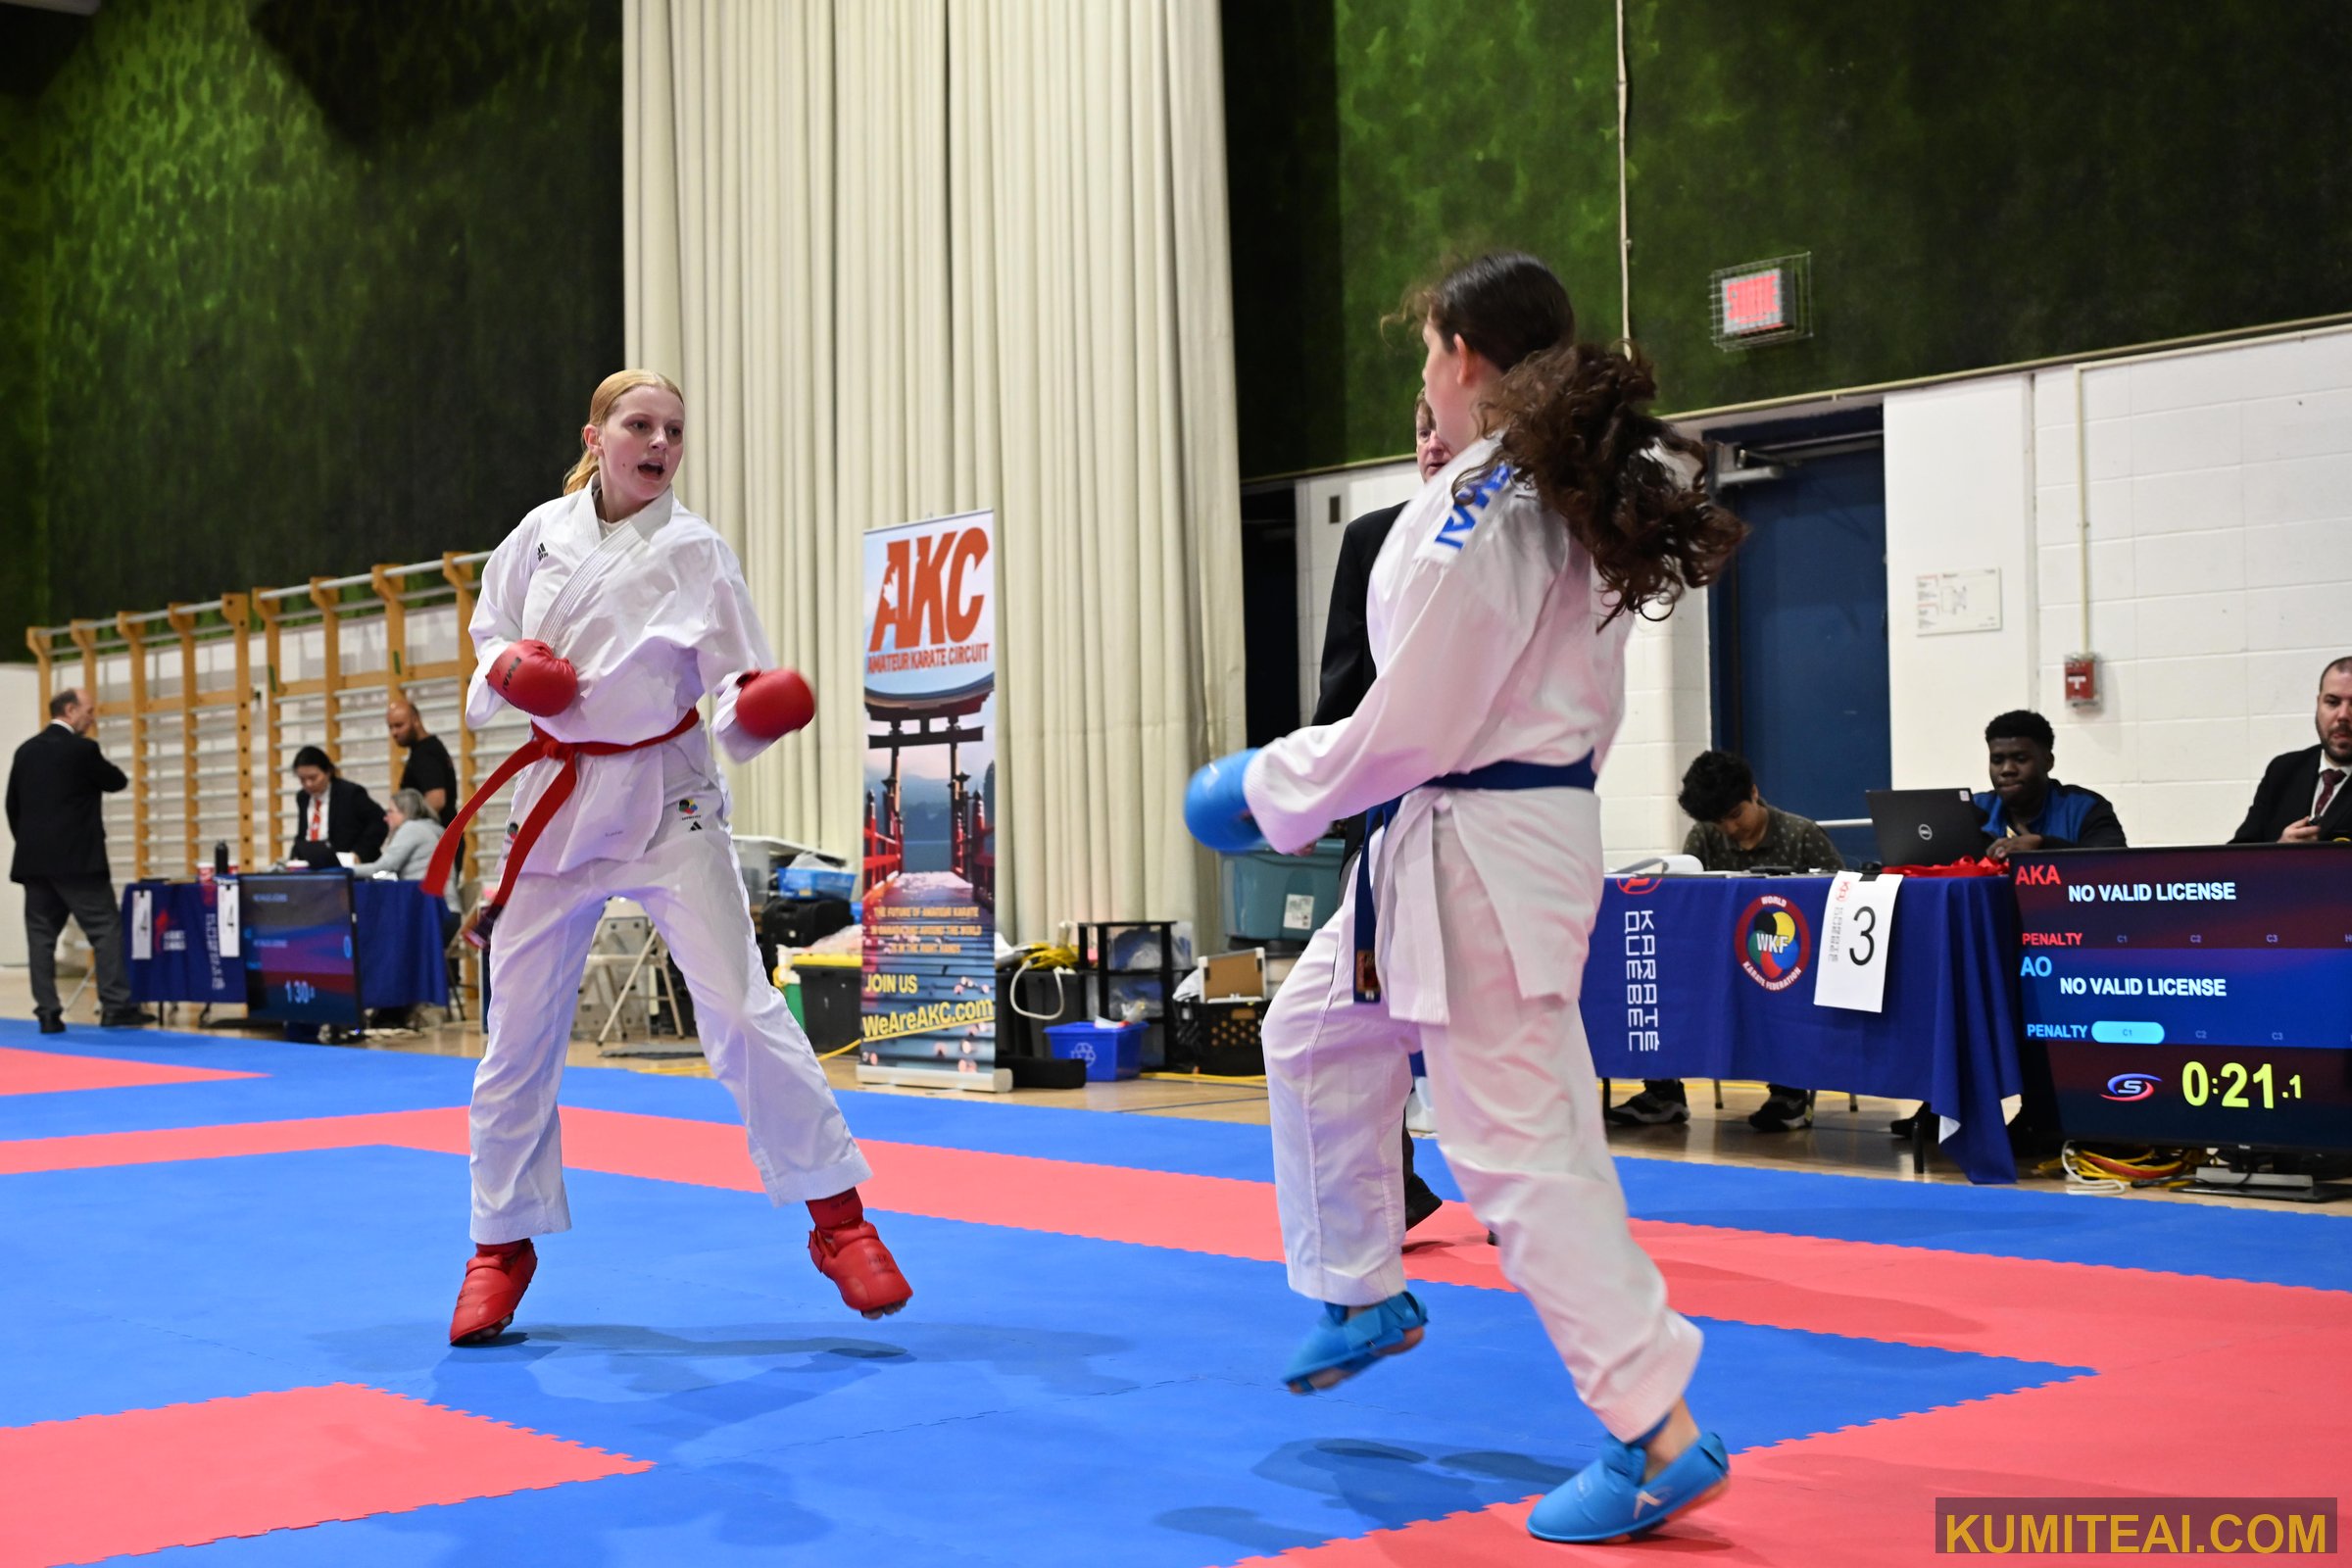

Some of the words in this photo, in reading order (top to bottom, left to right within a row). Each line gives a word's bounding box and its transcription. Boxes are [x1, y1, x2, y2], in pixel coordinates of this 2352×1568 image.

[869, 527, 989, 653] AKC
[867, 652, 909, 673] AMATEUR
[910, 648, 947, 670] KARATE
[948, 643, 989, 665] CIRCUIT
[2015, 864, 2061, 886] AKA
[1760, 896, 1788, 907] WORLD
[2068, 884, 2095, 903] NO
[2097, 883, 2152, 902] VALID
[2156, 882, 2236, 901] LICENSE
[1756, 933, 1789, 954] WKF
[1849, 906, 1877, 966] 3
[2022, 932, 2083, 946] PENALTY
[2189, 934, 2202, 944] C2
[2266, 934, 2278, 943] C3
[1741, 960, 1766, 987] KARATE
[1766, 966, 1802, 992] FEDERATION
[2020, 956, 2053, 977] AO
[864, 973, 896, 994] JOIN
[899, 974, 918, 994] US
[2060, 977, 2086, 995] NO
[2089, 978, 2143, 995] VALID
[2147, 978, 2228, 996] LICENSE
[862, 998, 994, 1038] WeAreAKC.com
[2027, 1023, 2088, 1039] PENALTY
[2195, 1030, 2207, 1039] C2
[2271, 1032, 2283, 1041] C3
